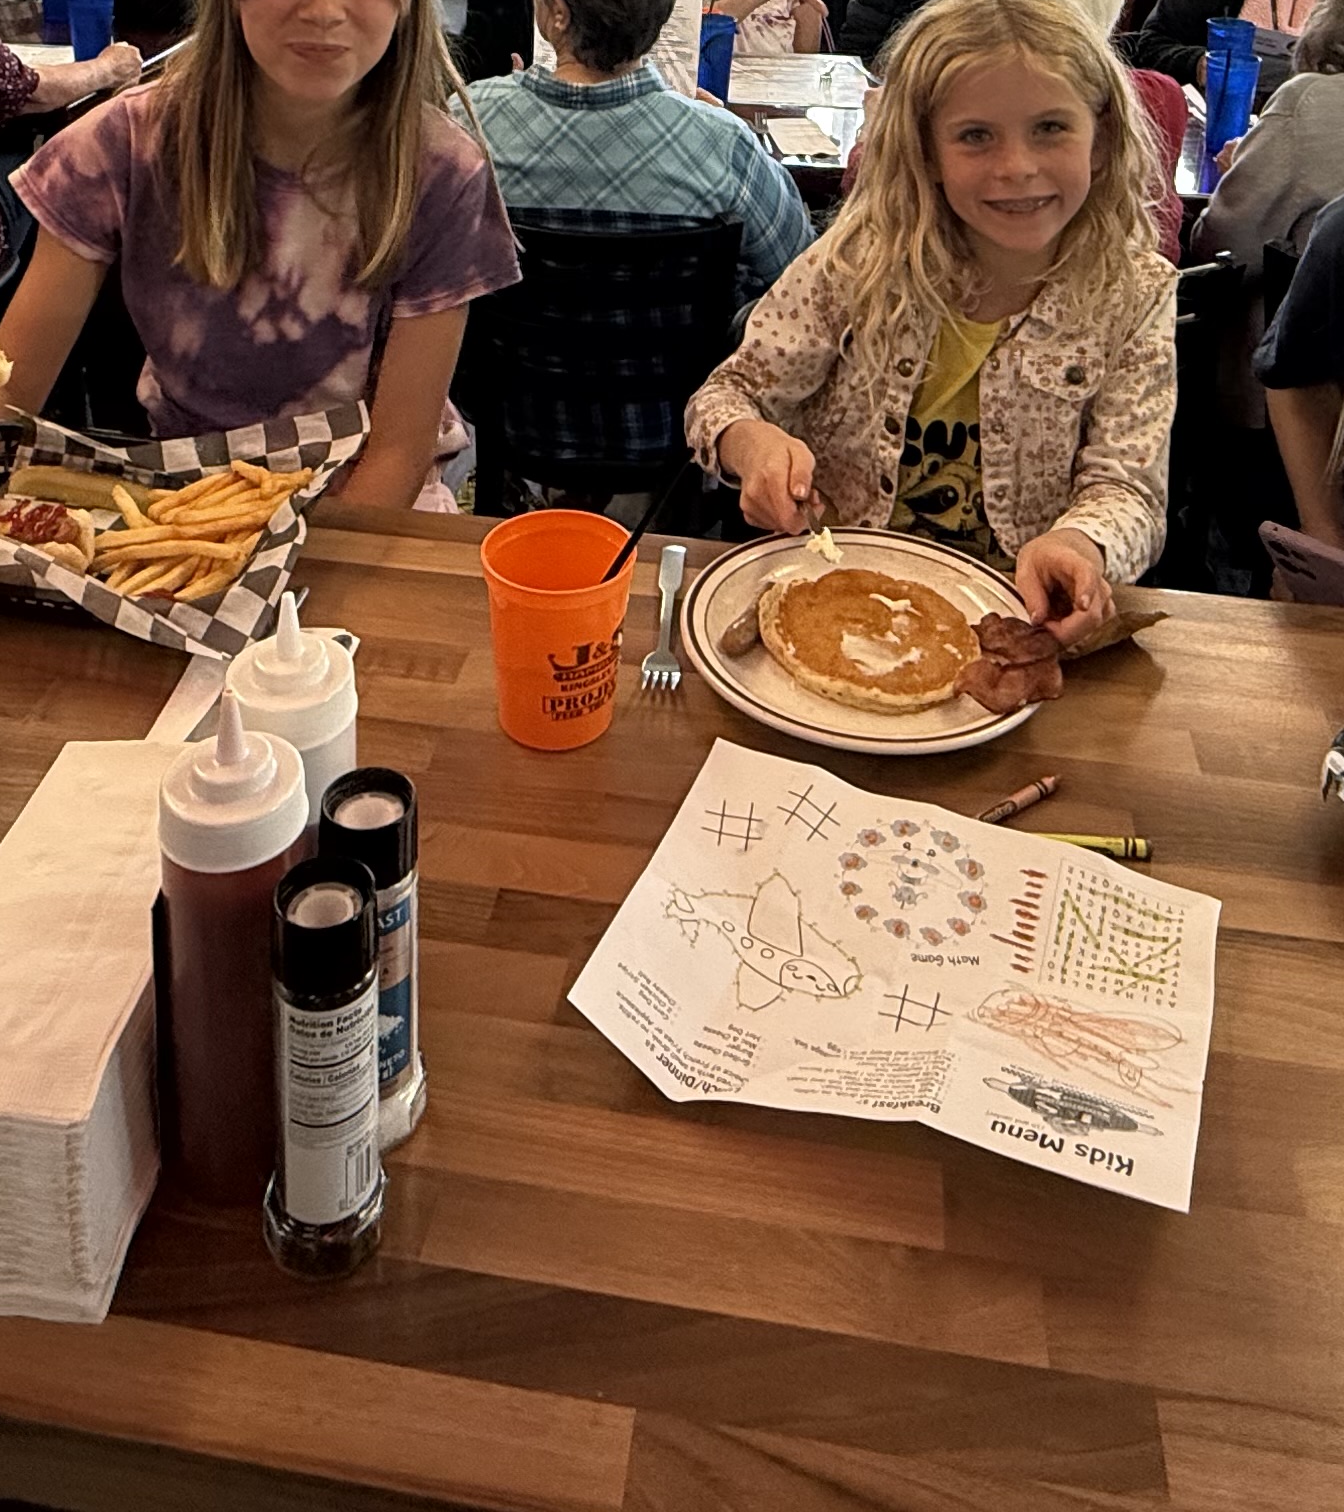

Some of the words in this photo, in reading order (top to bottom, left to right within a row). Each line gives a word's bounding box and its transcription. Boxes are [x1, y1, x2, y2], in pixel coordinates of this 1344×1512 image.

[910, 953, 945, 967] Game
[947, 955, 980, 967] Math
[871, 1100, 941, 1114] Breakfast
[990, 1119, 1065, 1154] Menu
[1074, 1144, 1135, 1178] Kids
